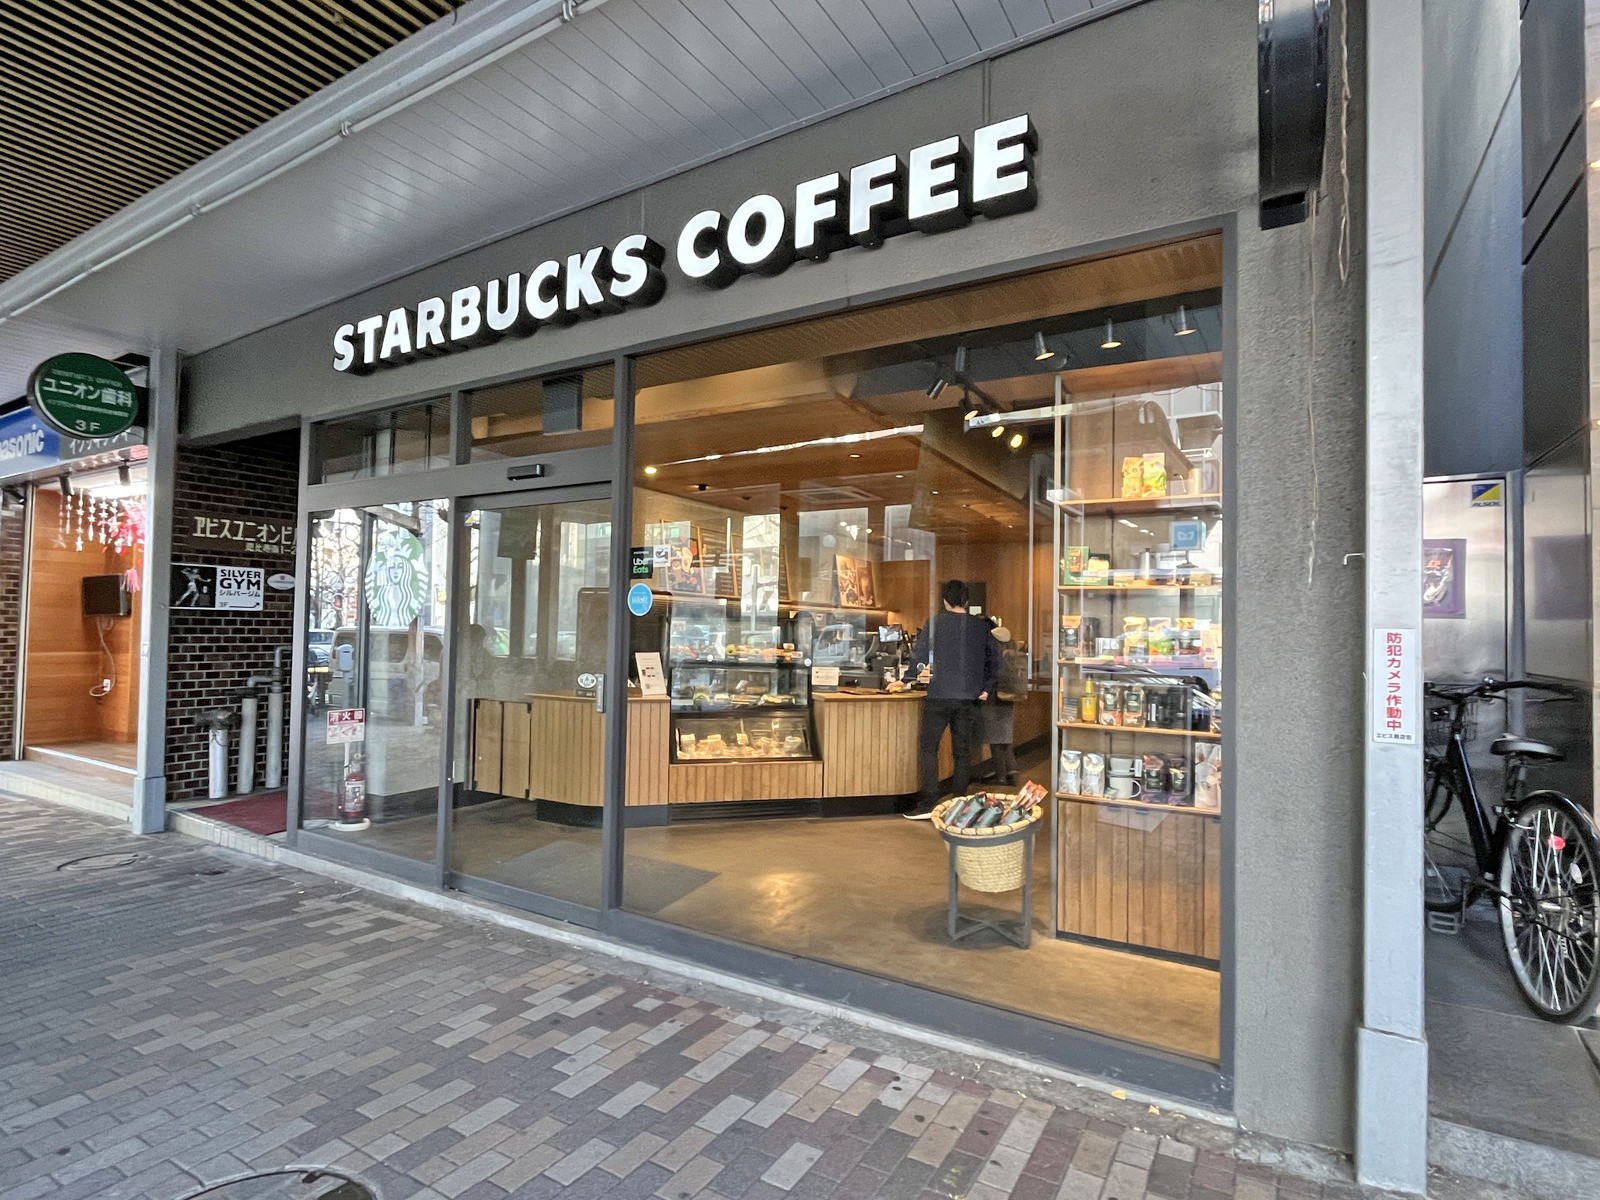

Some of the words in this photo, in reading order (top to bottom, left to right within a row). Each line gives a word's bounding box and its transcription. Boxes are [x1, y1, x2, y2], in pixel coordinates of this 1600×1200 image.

[332, 234, 648, 373] STARBUCKS
[676, 114, 1029, 279] COFFEE
[42, 377, 133, 408] ユニオン歯科
[75, 419, 101, 432] 3F
[0, 423, 45, 459] asonic
[633, 558, 649, 566] Uber
[220, 568, 261, 579] SILVER
[633, 566, 648, 574] Eats
[219, 578, 261, 591] GYM
[219, 590, 261, 598] シルバージム
[1386, 632, 1403, 731] 防犯カメラ作動中
